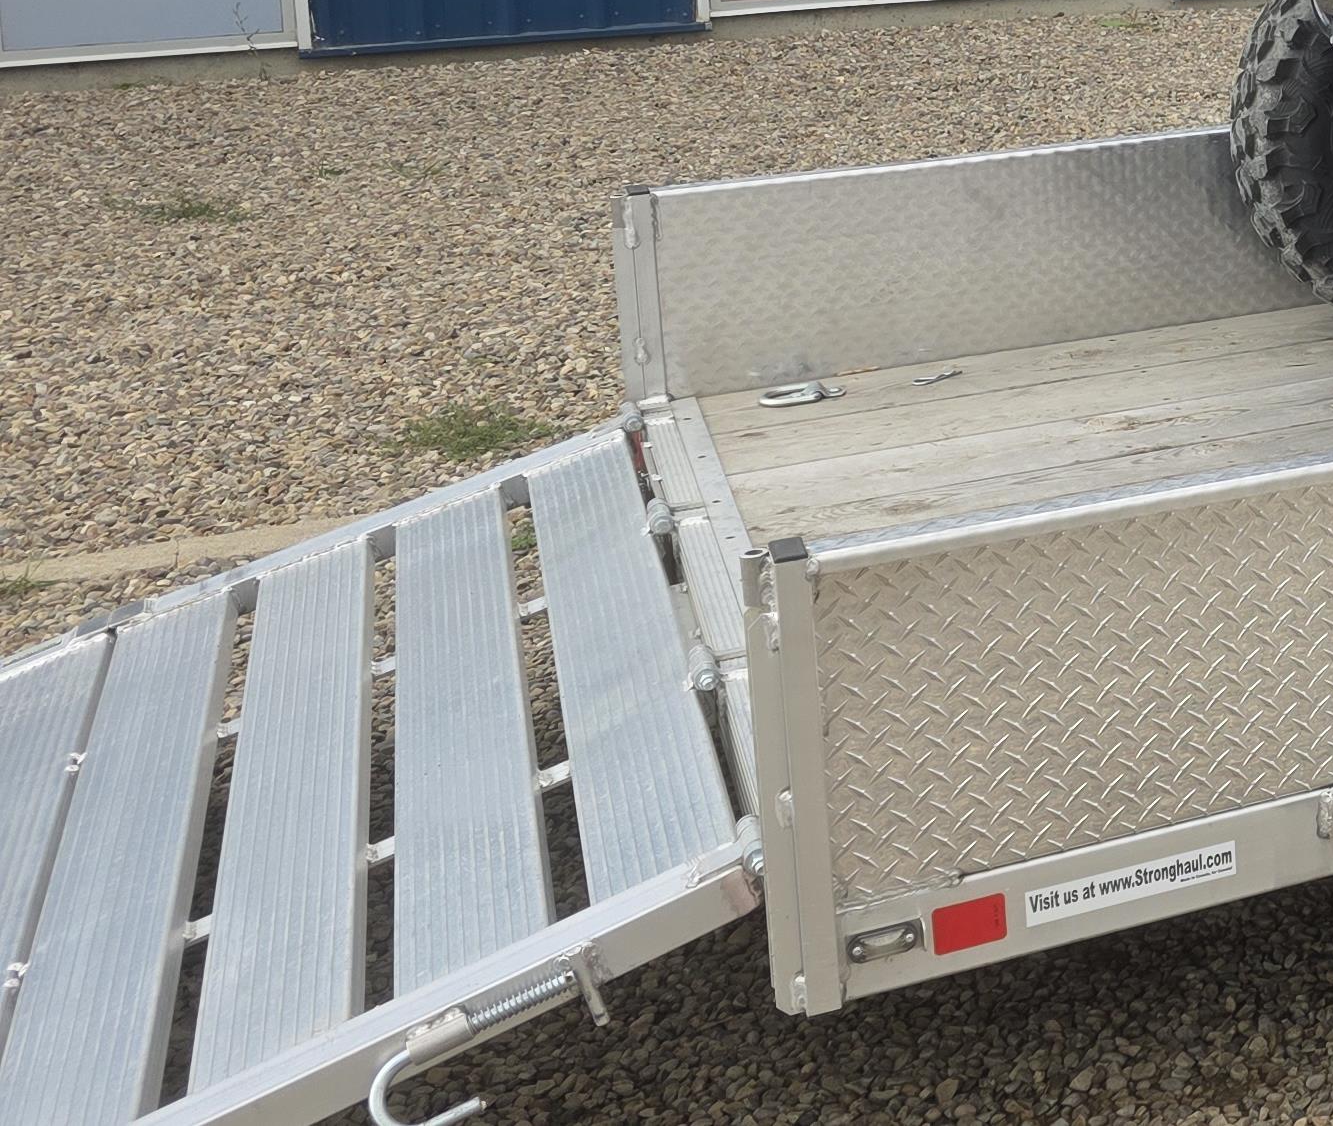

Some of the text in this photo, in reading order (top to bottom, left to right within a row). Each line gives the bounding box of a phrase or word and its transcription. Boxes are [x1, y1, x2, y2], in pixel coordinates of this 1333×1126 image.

[1029, 890, 1060, 913] Visit
[1063, 888, 1079, 905] us
[1082, 881, 1096, 900] at
[1098, 850, 1233, 896] www.Stronghaul.com
